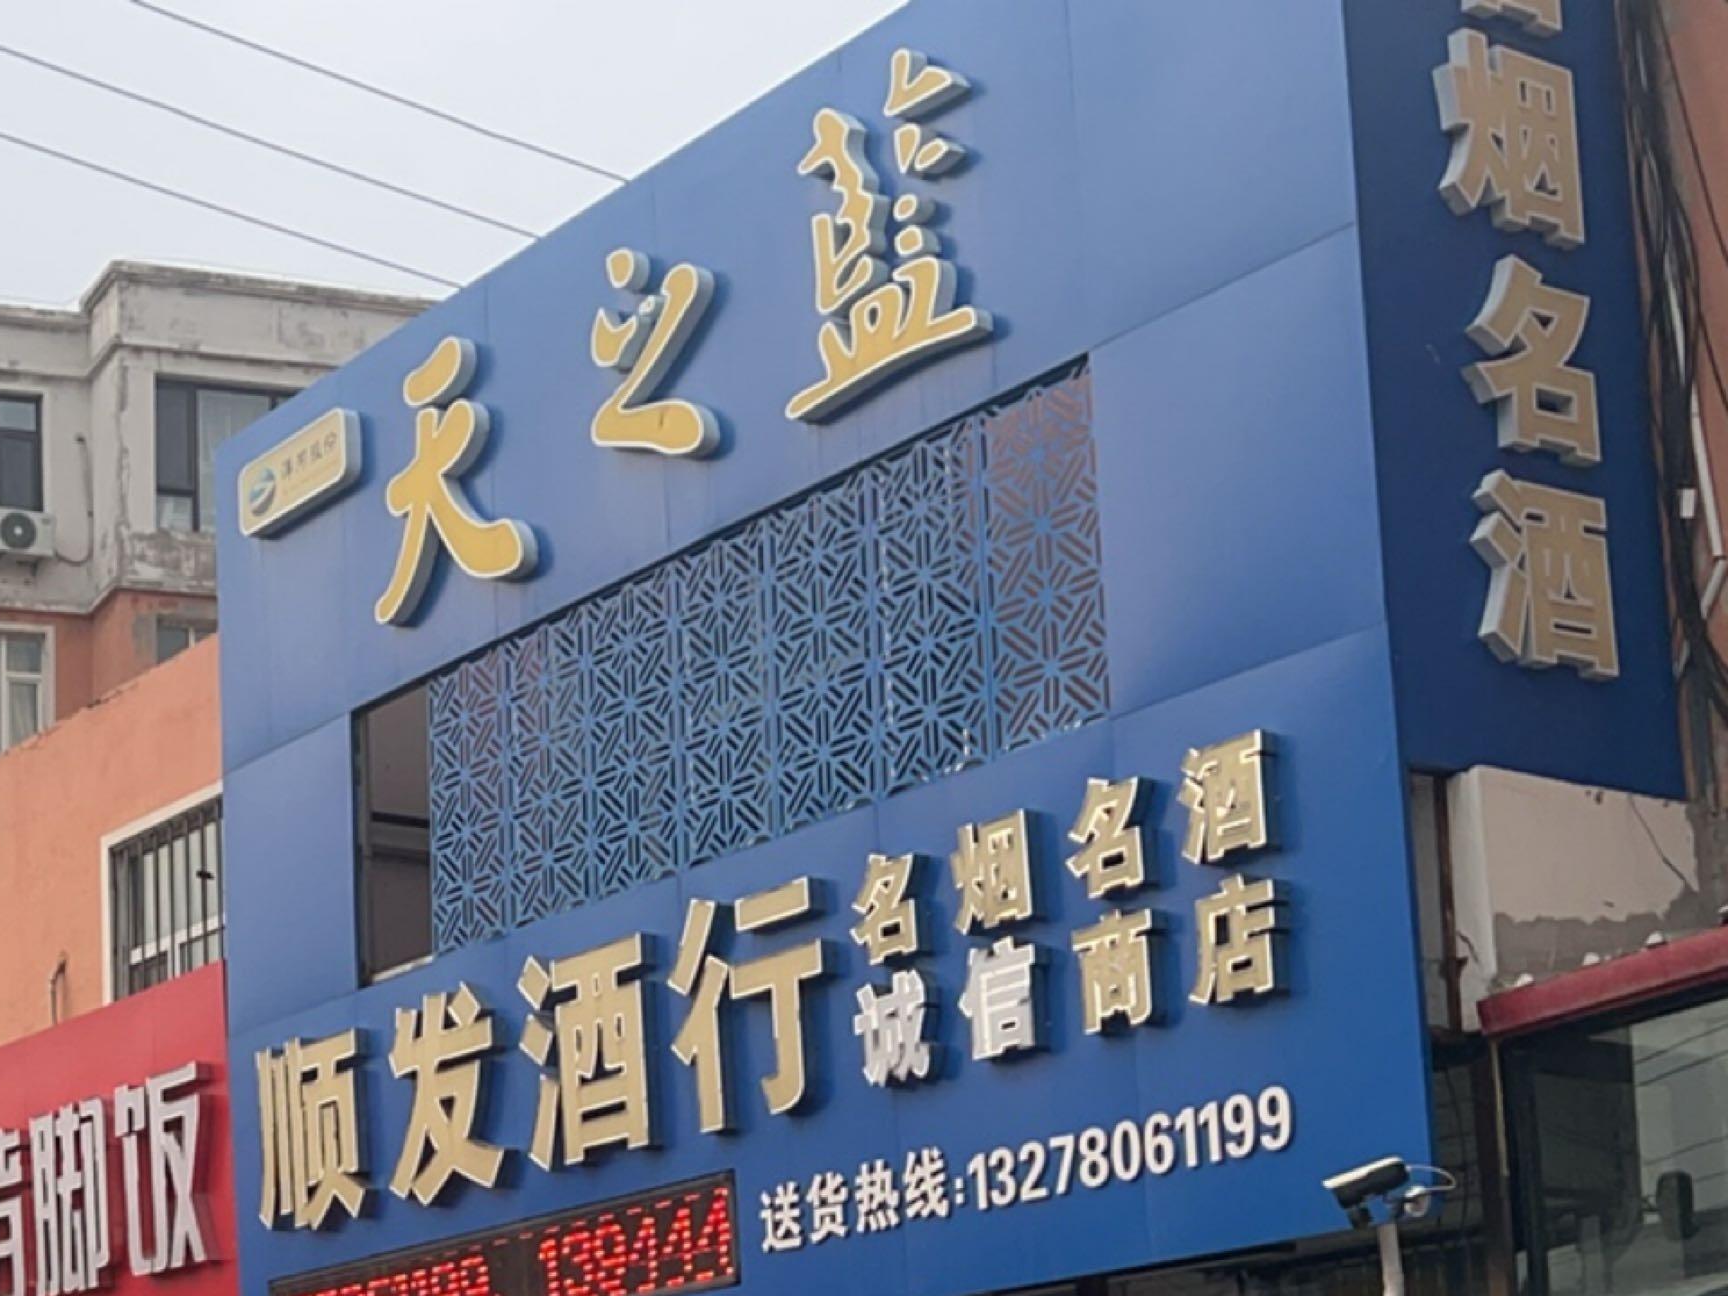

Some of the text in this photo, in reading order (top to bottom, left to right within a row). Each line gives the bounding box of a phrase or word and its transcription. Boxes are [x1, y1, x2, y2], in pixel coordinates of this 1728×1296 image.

[1432, 0, 1621, 682] 烟名酒
[851, 729, 1276, 965] 名烟名酒
[853, 874, 1280, 1086] 诚信商店
[255, 876, 828, 1230] 顺发酒行
